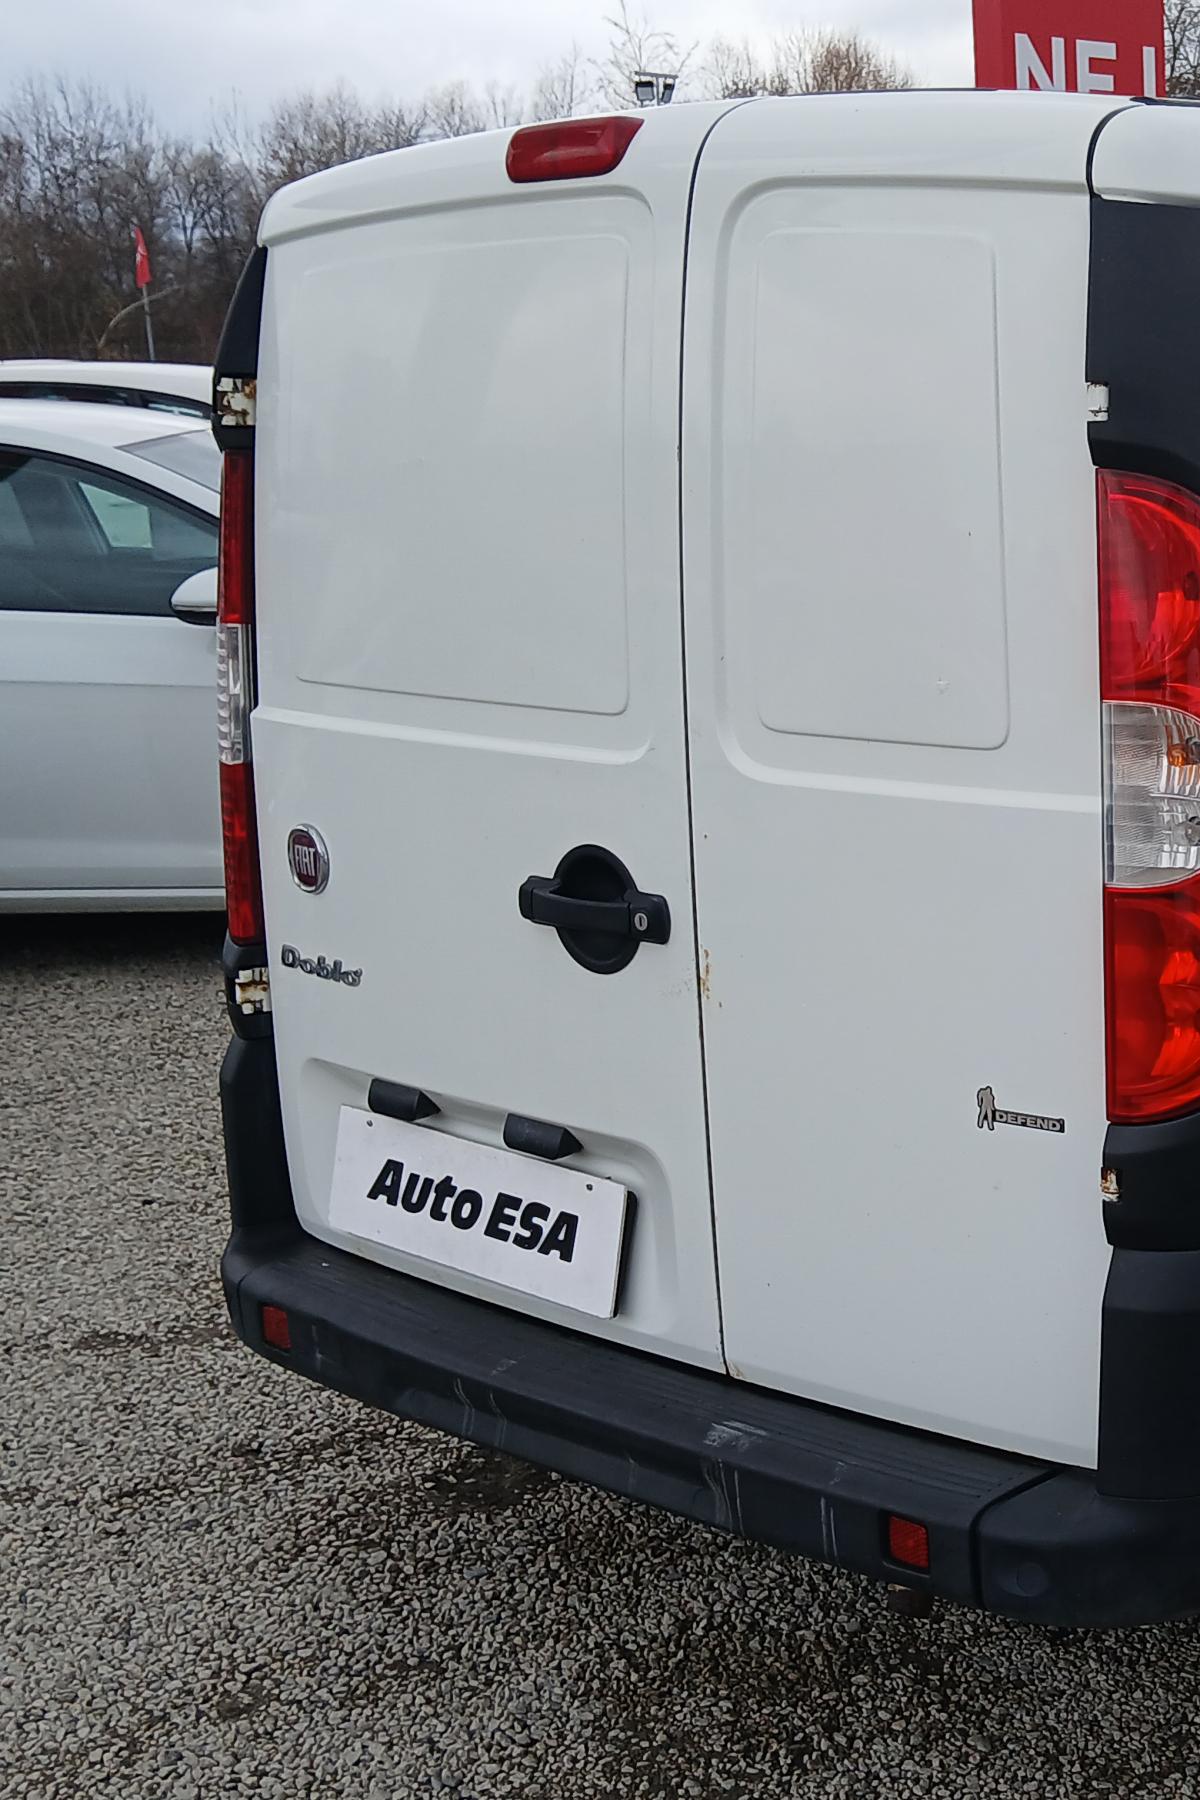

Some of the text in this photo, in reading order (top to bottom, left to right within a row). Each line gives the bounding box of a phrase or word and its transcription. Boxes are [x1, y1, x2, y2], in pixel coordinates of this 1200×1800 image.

[294, 844, 316, 877] FIAT
[994, 1110, 1062, 1132] DEFEND
[367, 1158, 579, 1263] Auto ESA
